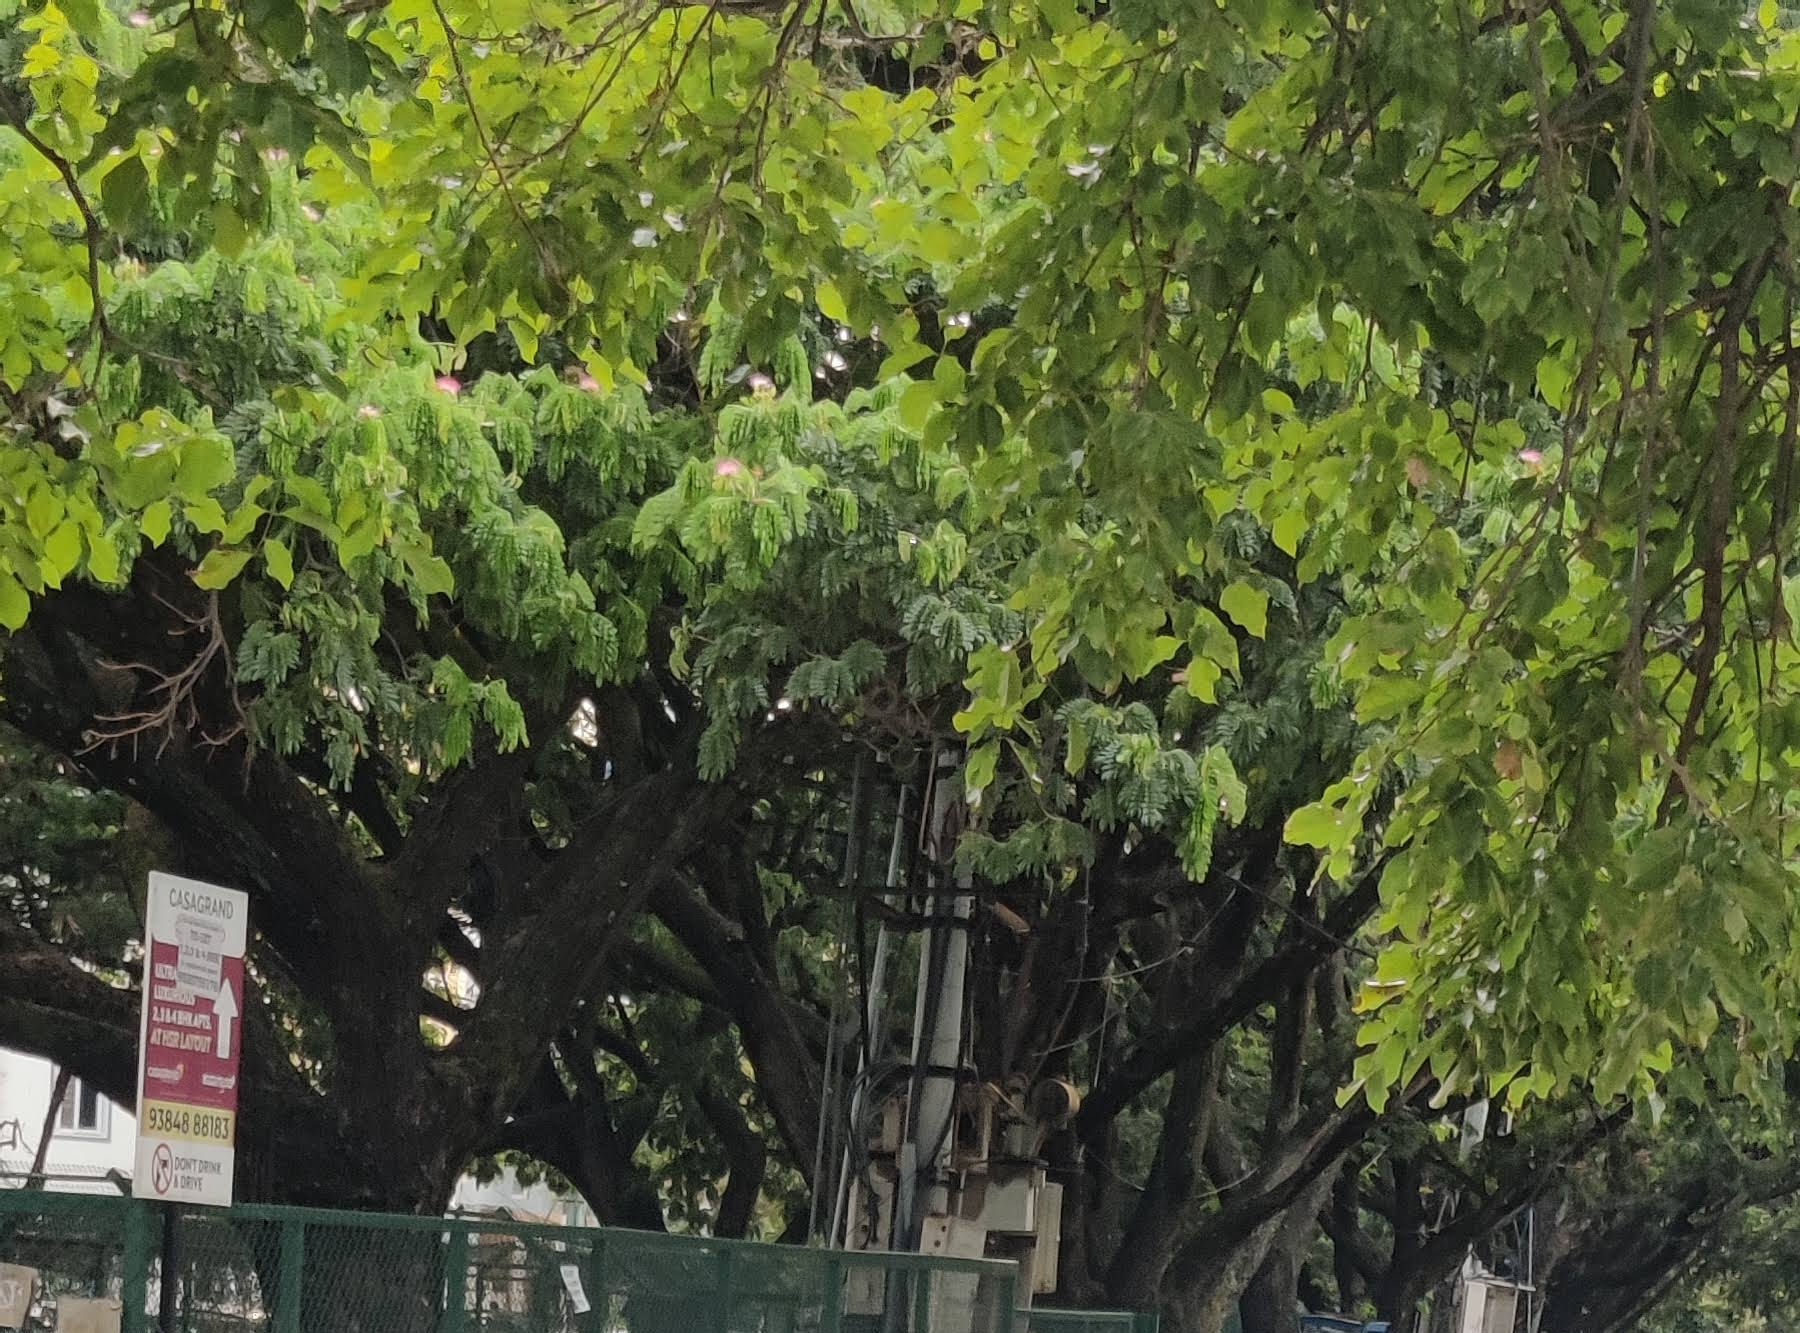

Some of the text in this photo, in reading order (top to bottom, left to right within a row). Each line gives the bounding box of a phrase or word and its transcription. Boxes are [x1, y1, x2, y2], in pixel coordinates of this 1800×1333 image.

[169, 887, 234, 919] CASAGRAND
[150, 1027, 162, 1046] AT
[180, 1031, 213, 1053] LAYOUT
[149, 1107, 231, 1139] 93848 88183
[198, 1159, 222, 1175] DRINK
[180, 1176, 203, 1192] DRIVE
